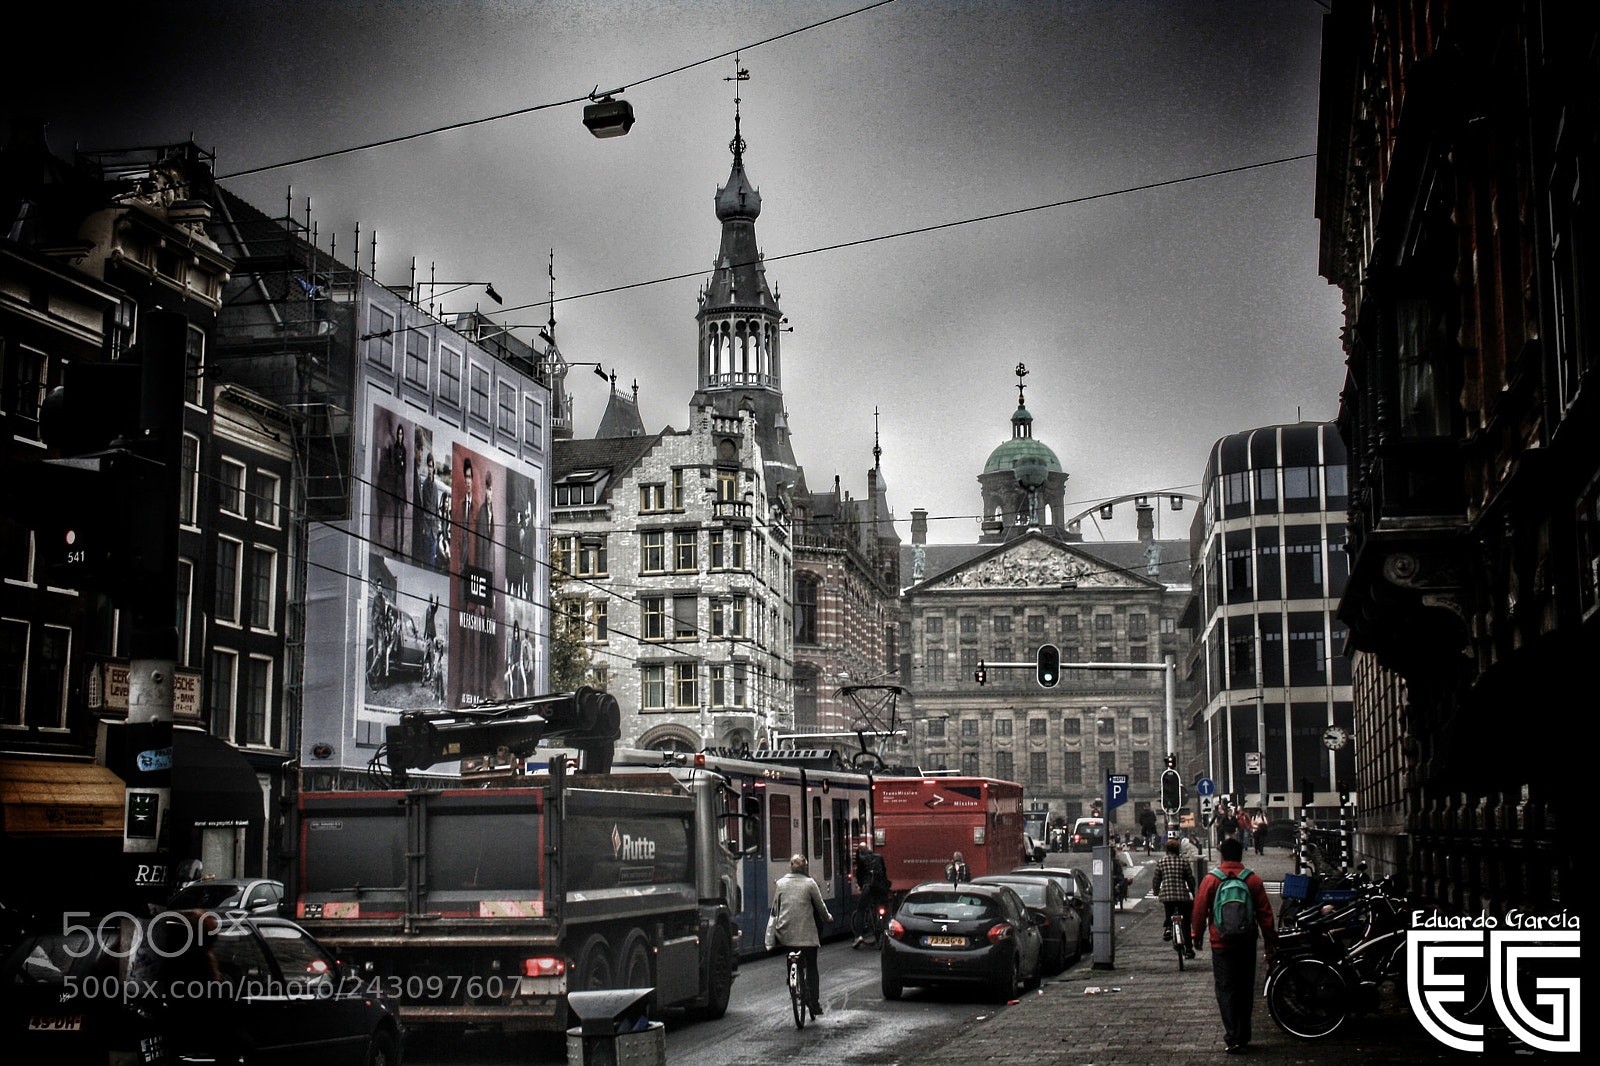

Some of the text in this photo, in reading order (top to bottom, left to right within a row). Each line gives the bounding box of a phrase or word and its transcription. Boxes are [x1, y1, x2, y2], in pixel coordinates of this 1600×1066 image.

[67, 550, 85, 563] 541
[470, 573, 487, 598] WE
[1113, 785, 1122, 800] P
[622, 833, 656, 861] Rutte
